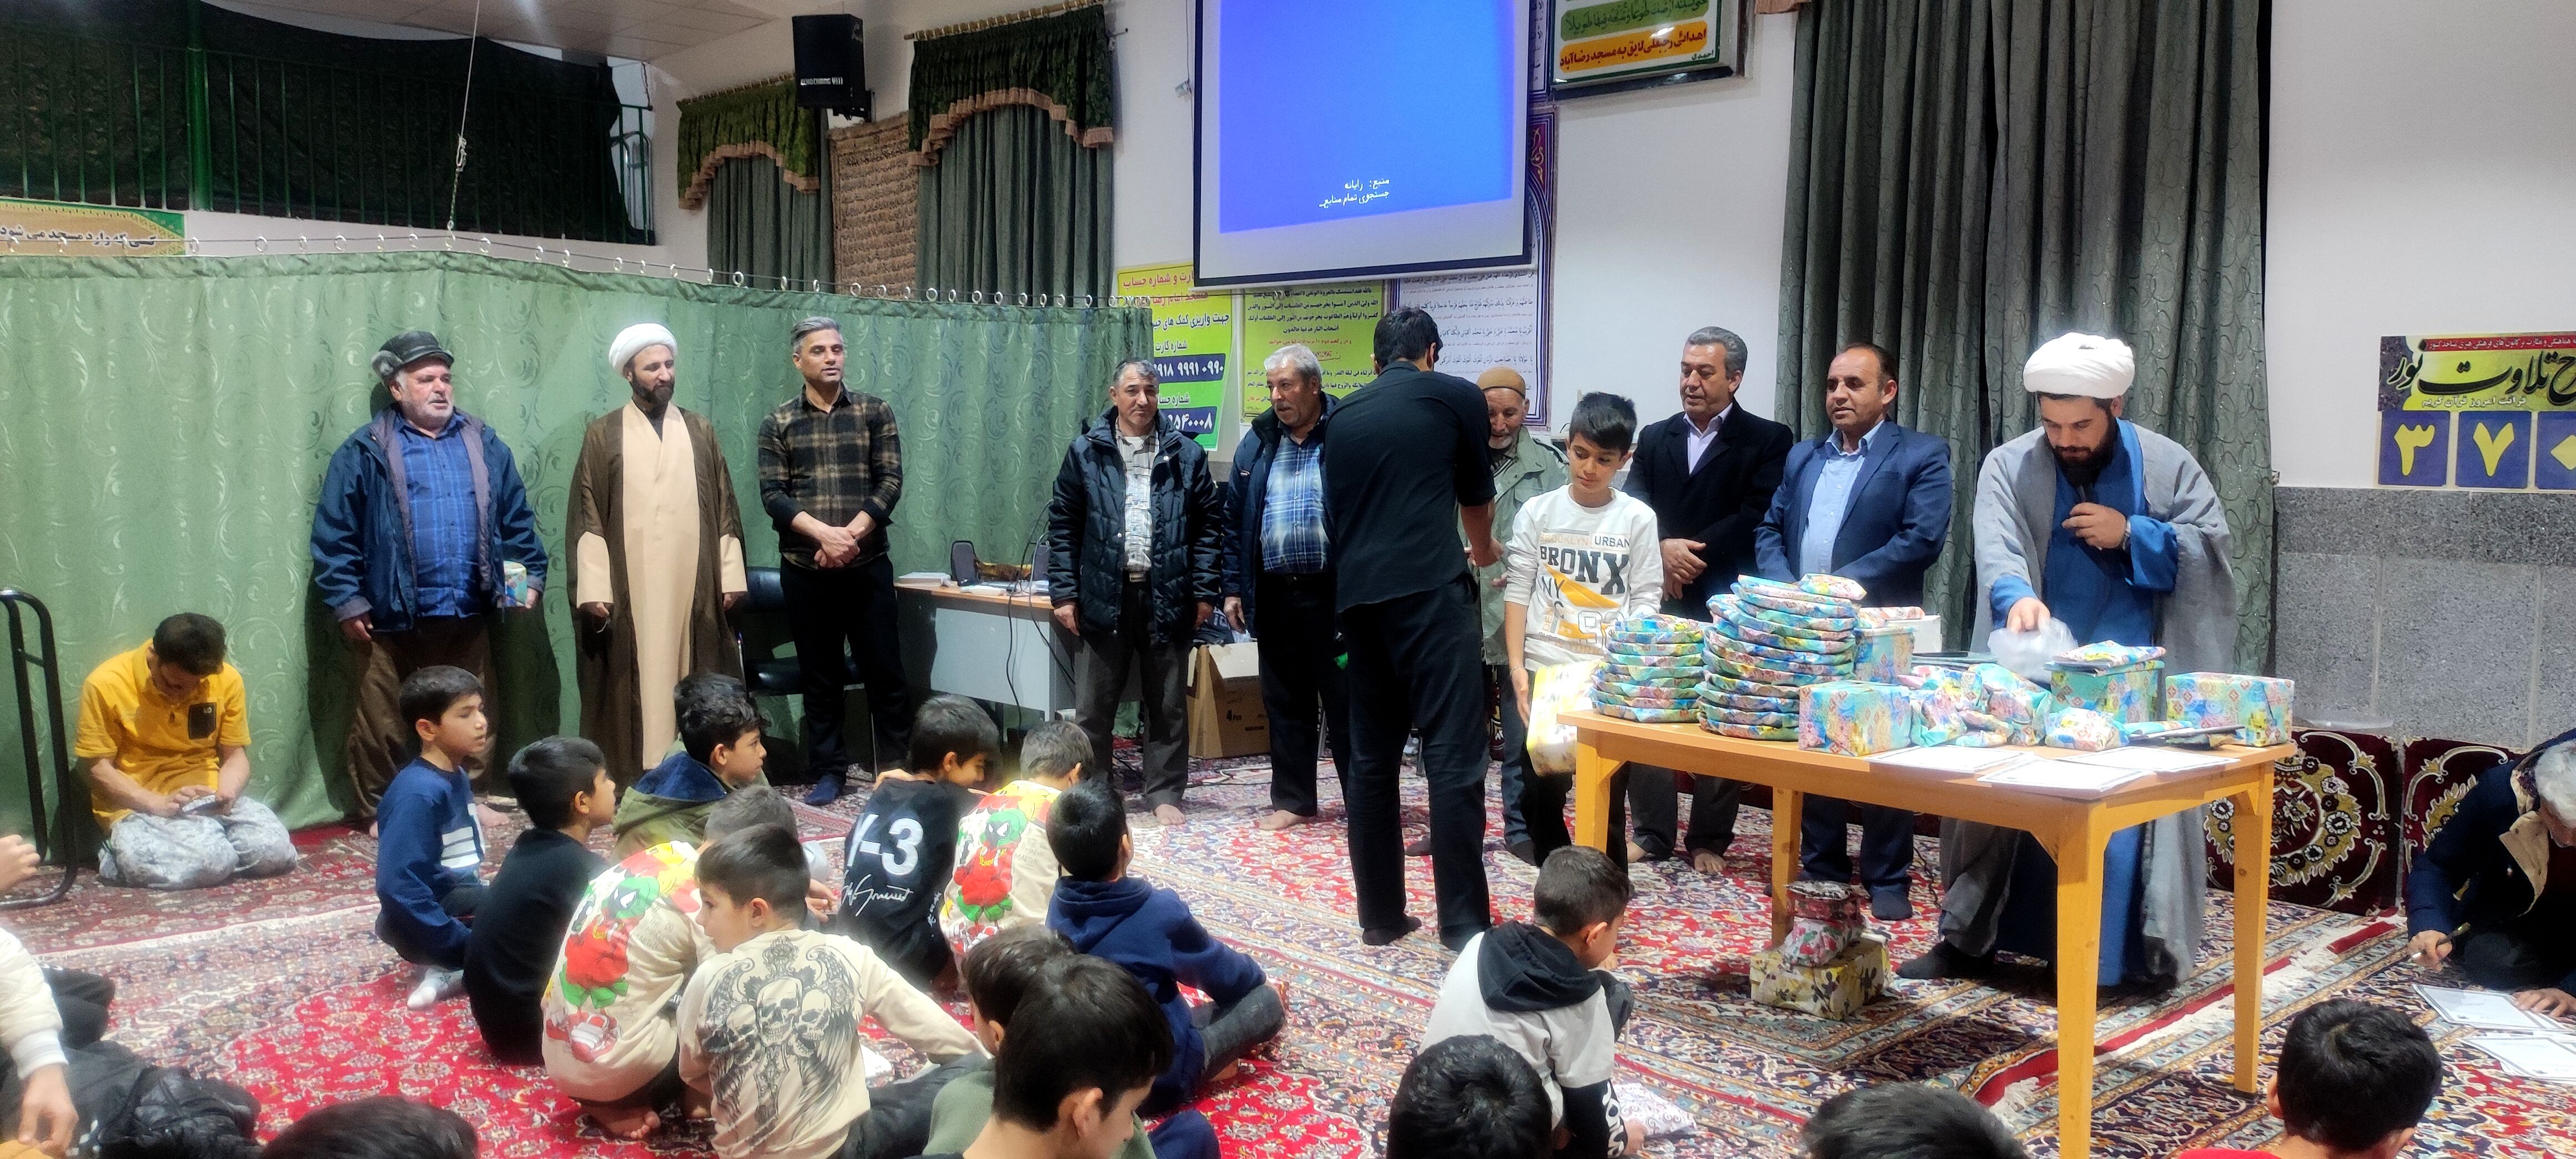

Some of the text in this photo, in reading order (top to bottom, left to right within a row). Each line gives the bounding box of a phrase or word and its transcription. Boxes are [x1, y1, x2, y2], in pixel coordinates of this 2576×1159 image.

[1589, 48, 1617, 64] مسجد
[1617, 48, 1627, 59] به
[1344, 179, 1364, 192] رایانه
[1342, 193, 1358, 206] تمام
[1359, 190, 1390, 204] جستجوی
[26, 231, 46, 240] می
[48, 230, 83, 240] مسجد
[1123, 269, 1194, 290] ارت و شماره حساب
[1163, 316, 1174, 331] های
[1176, 314, 1189, 326] کمک
[1190, 313, 1210, 329] واریزی
[1212, 314, 1229, 326] جهت
[1155, 340, 1188, 354] شماره کارت
[1178, 361, 1199, 376] ۹۹۹۱
[1201, 360, 1224, 375] ۰۹۹۰
[2387, 339, 2428, 390] نور
[2417, 350, 2558, 395] تلاوت
[1159, 393, 1190, 406] شماره حسا
[2421, 395, 2444, 408] کریم
[2445, 394, 2468, 408] قرآن
[2469, 395, 2496, 408] امروز
[2394, 424, 2436, 476] ۳
[2473, 422, 2515, 477] ۷
[1539, 546, 1630, 594] BRONX
